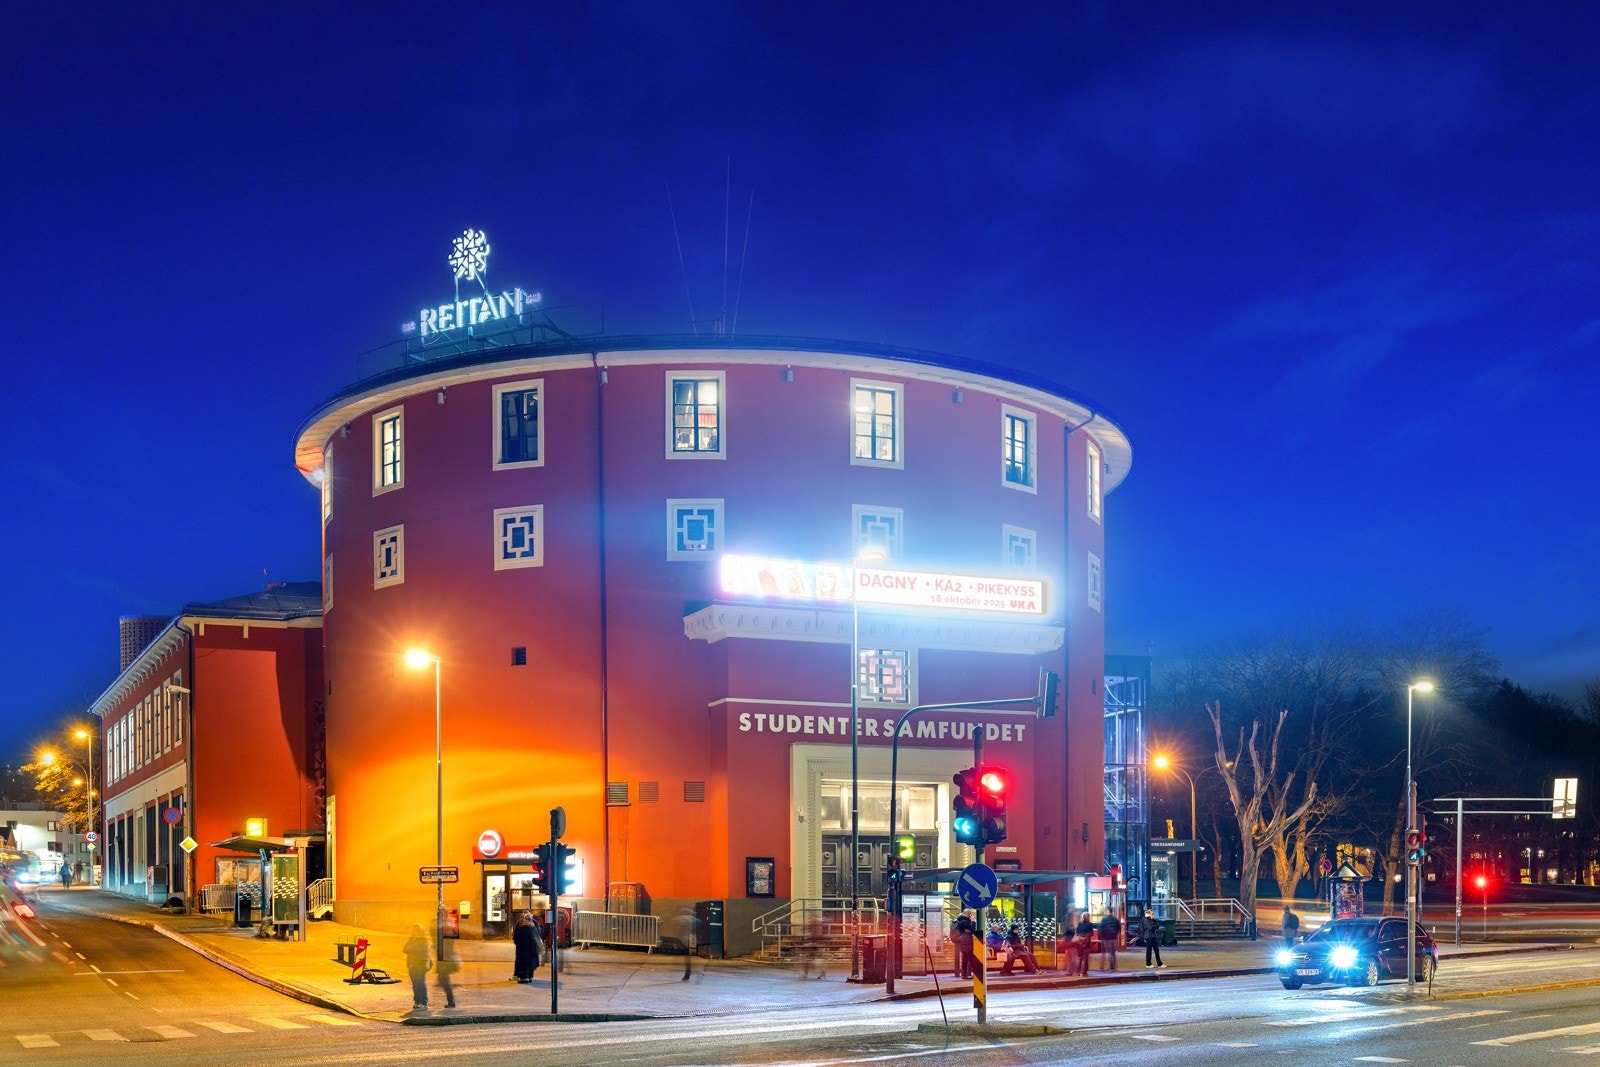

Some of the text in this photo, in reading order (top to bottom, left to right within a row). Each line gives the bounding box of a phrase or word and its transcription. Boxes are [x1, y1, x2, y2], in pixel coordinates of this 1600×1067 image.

[420, 288, 523, 336] REITAN
[860, 573, 1035, 597] DAGNY KA2 PIKEKYSS
[983, 599, 1006, 608] 2025
[1010, 600, 1036, 610] UKA
